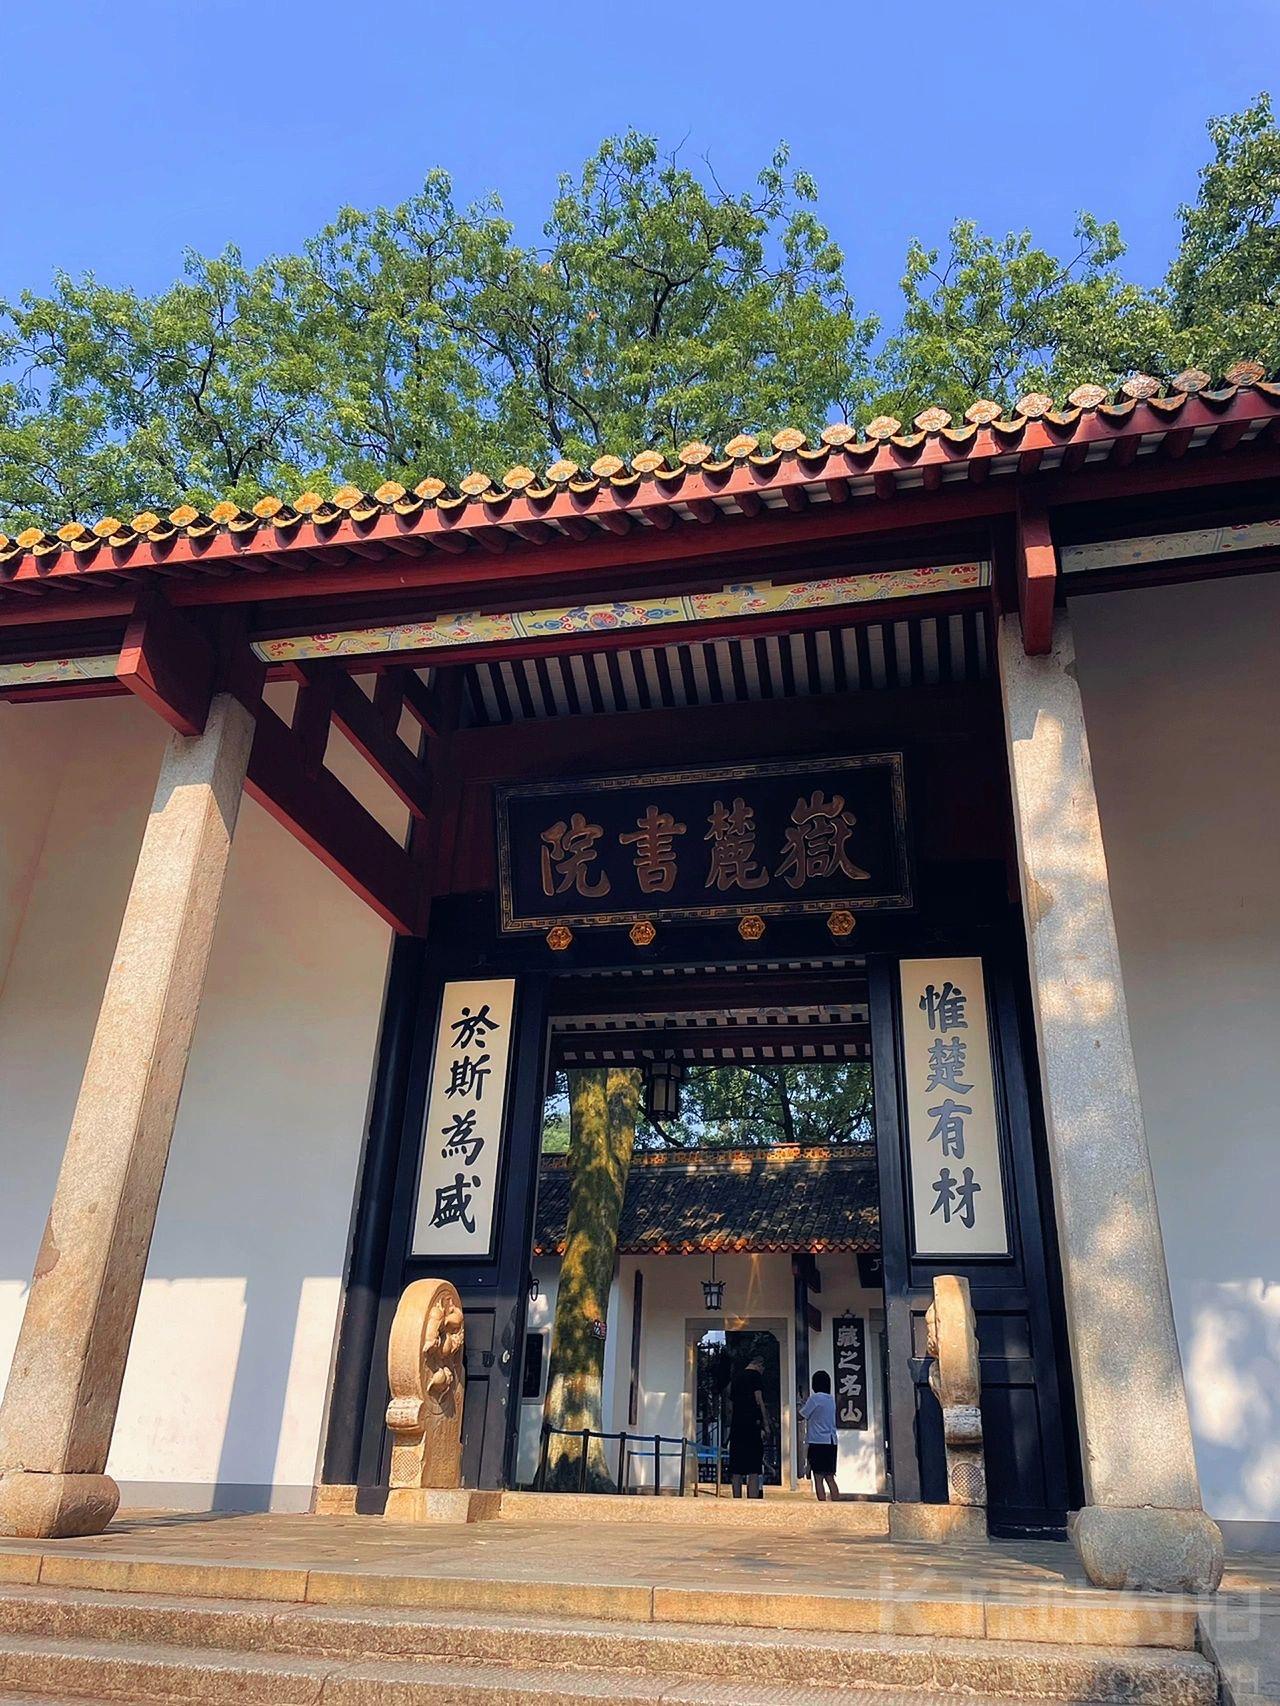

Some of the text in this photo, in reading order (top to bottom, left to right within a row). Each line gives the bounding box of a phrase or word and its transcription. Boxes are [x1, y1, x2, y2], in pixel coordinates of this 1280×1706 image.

[428, 1004, 501, 1234] 於斯為盛
[918, 981, 982, 1229] 惟楚有材
[836, 1325, 863, 1423] 藏之名山
